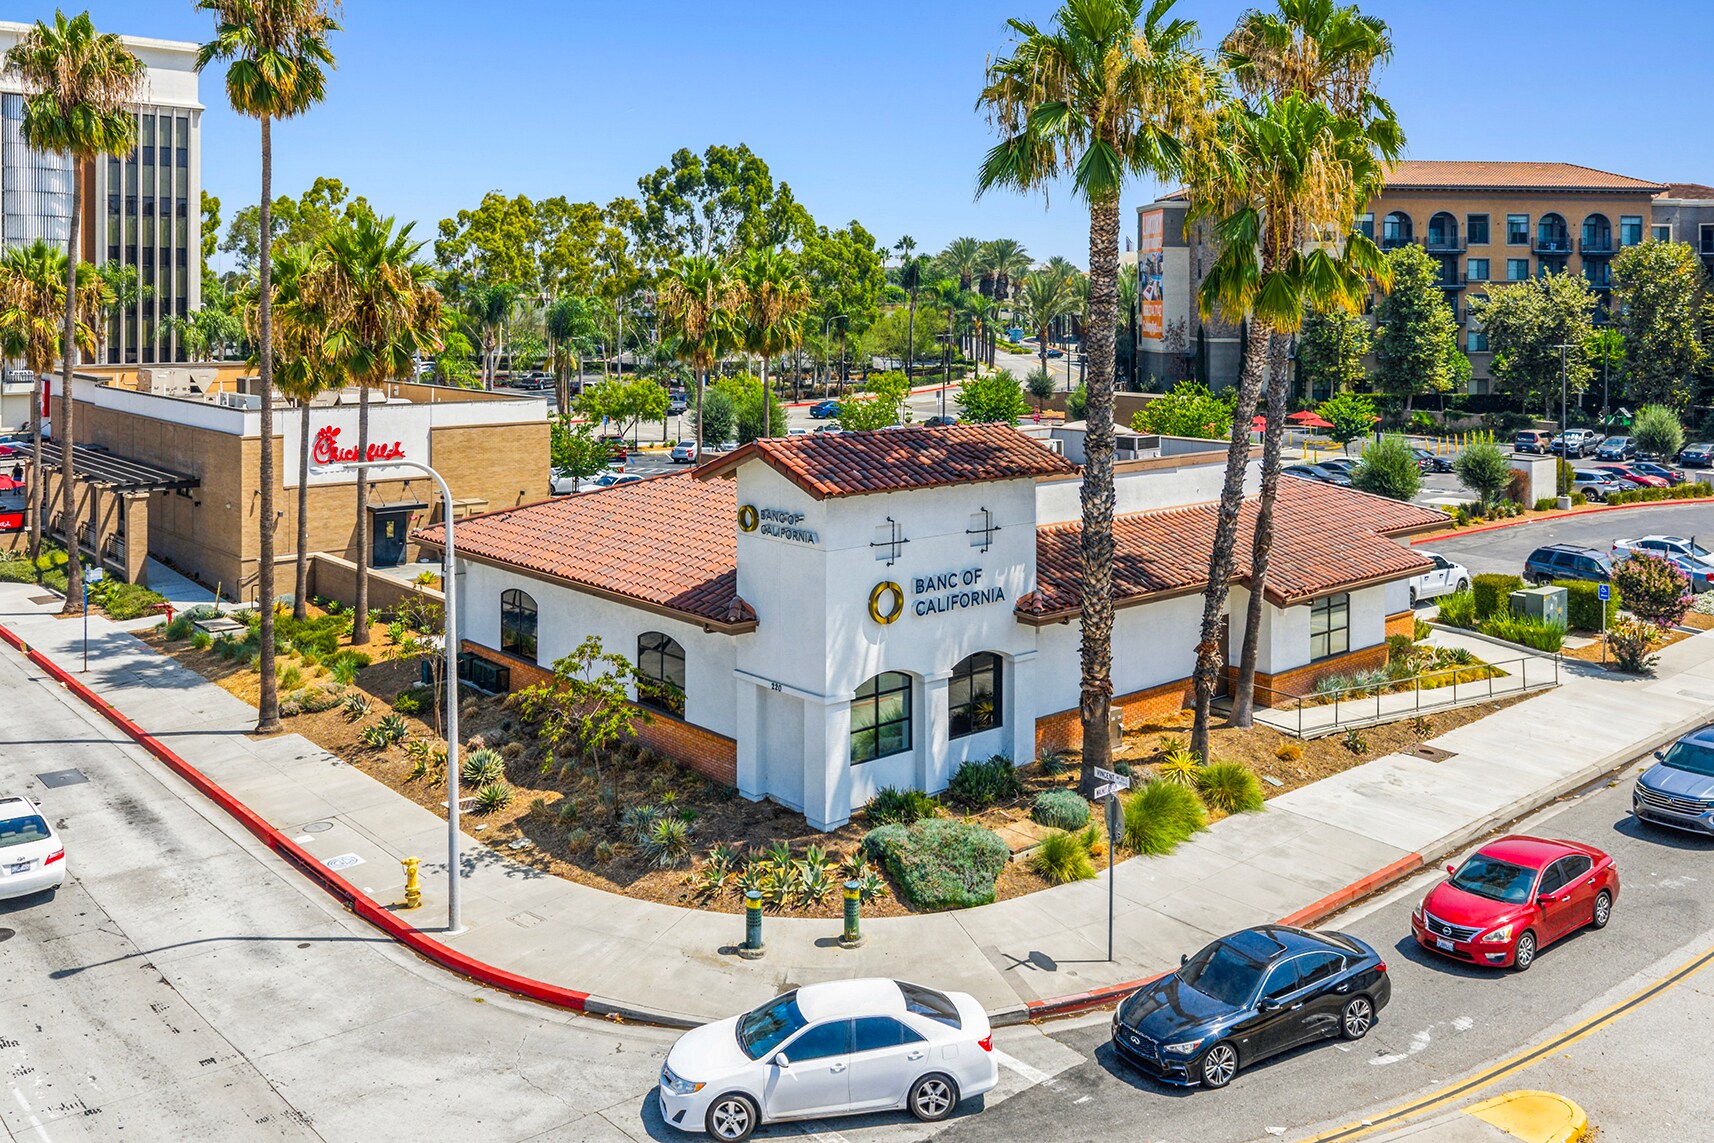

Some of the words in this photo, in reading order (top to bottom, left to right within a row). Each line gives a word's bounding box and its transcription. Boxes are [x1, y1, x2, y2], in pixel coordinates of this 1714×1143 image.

[313, 425, 406, 465] Chickfil-A
[760, 509, 787, 524] BANC
[788, 513, 804, 526] OF
[760, 524, 817, 545] CALIFORNIA
[915, 573, 958, 594] BANC
[962, 568, 982, 586] OF
[915, 587, 1005, 616] CALIFORNIA
[771, 682, 783, 692] 220
[1096, 769, 1115, 780] VINCENT
